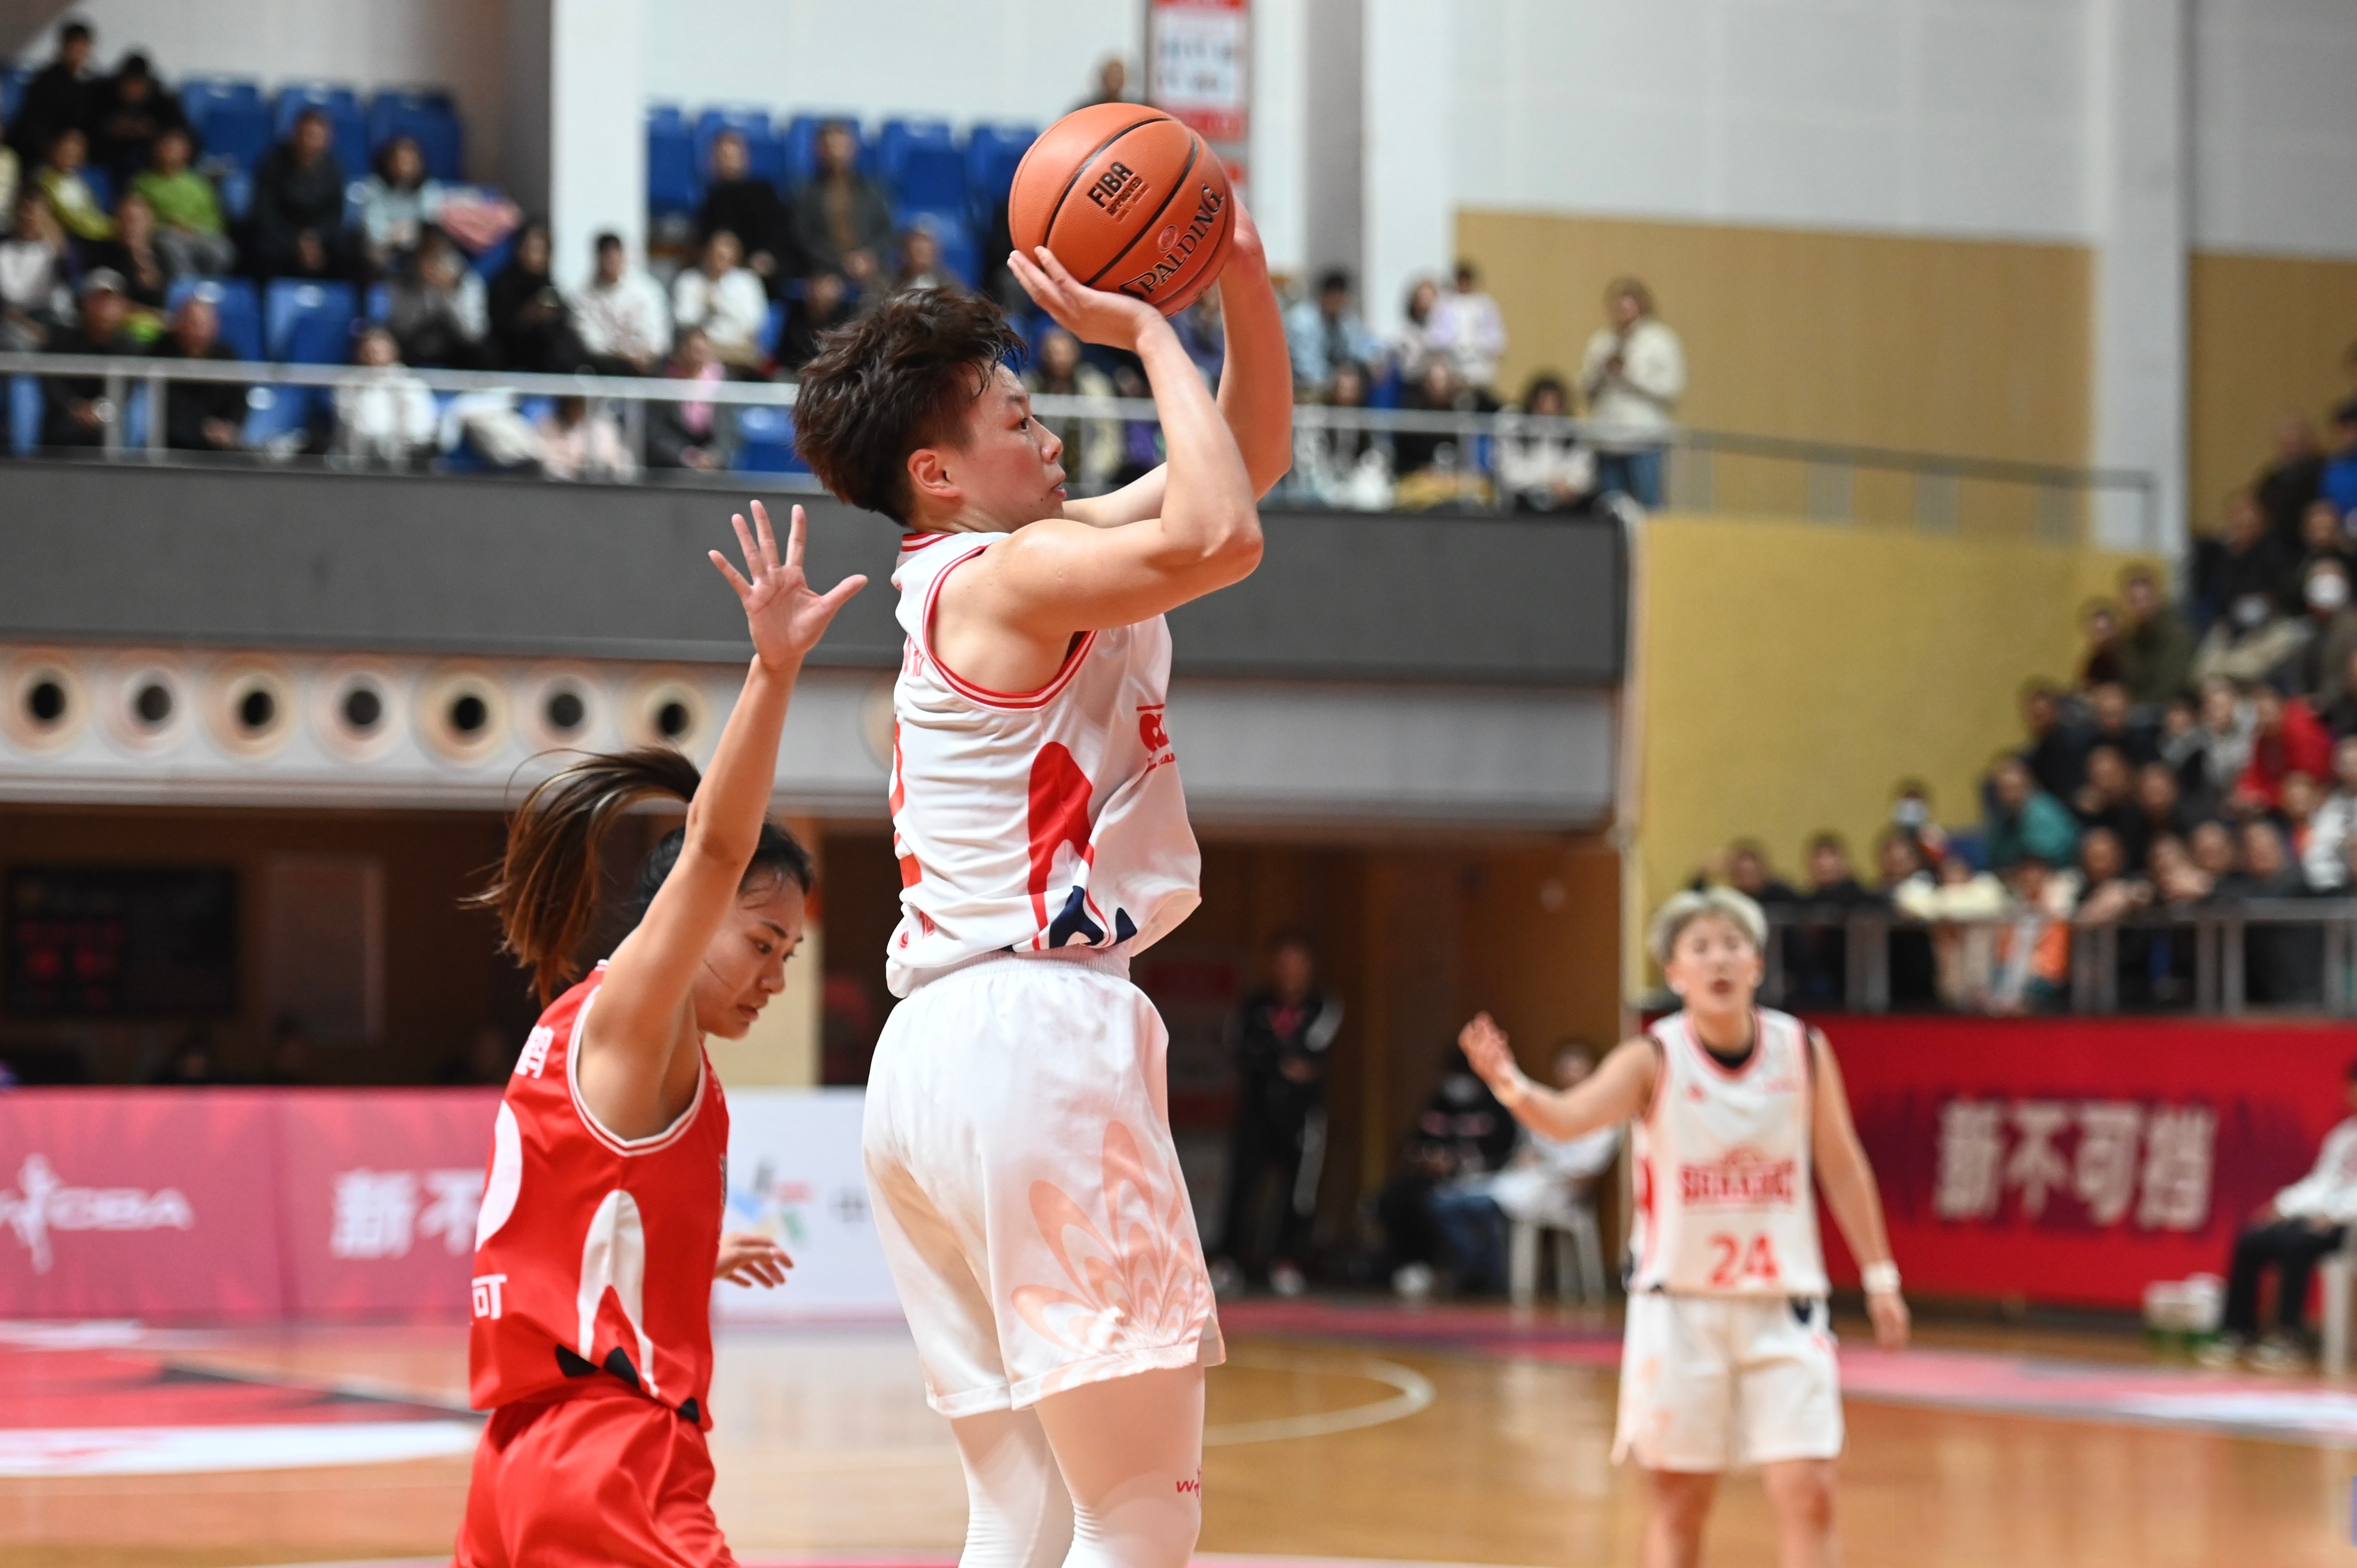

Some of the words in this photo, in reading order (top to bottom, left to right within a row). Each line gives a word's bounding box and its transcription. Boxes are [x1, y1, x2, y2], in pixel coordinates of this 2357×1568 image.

[1087, 161, 1134, 208] FIBA
[1932, 1097, 2219, 1232] 新不可挡
[1709, 1232, 1778, 1287] 24
